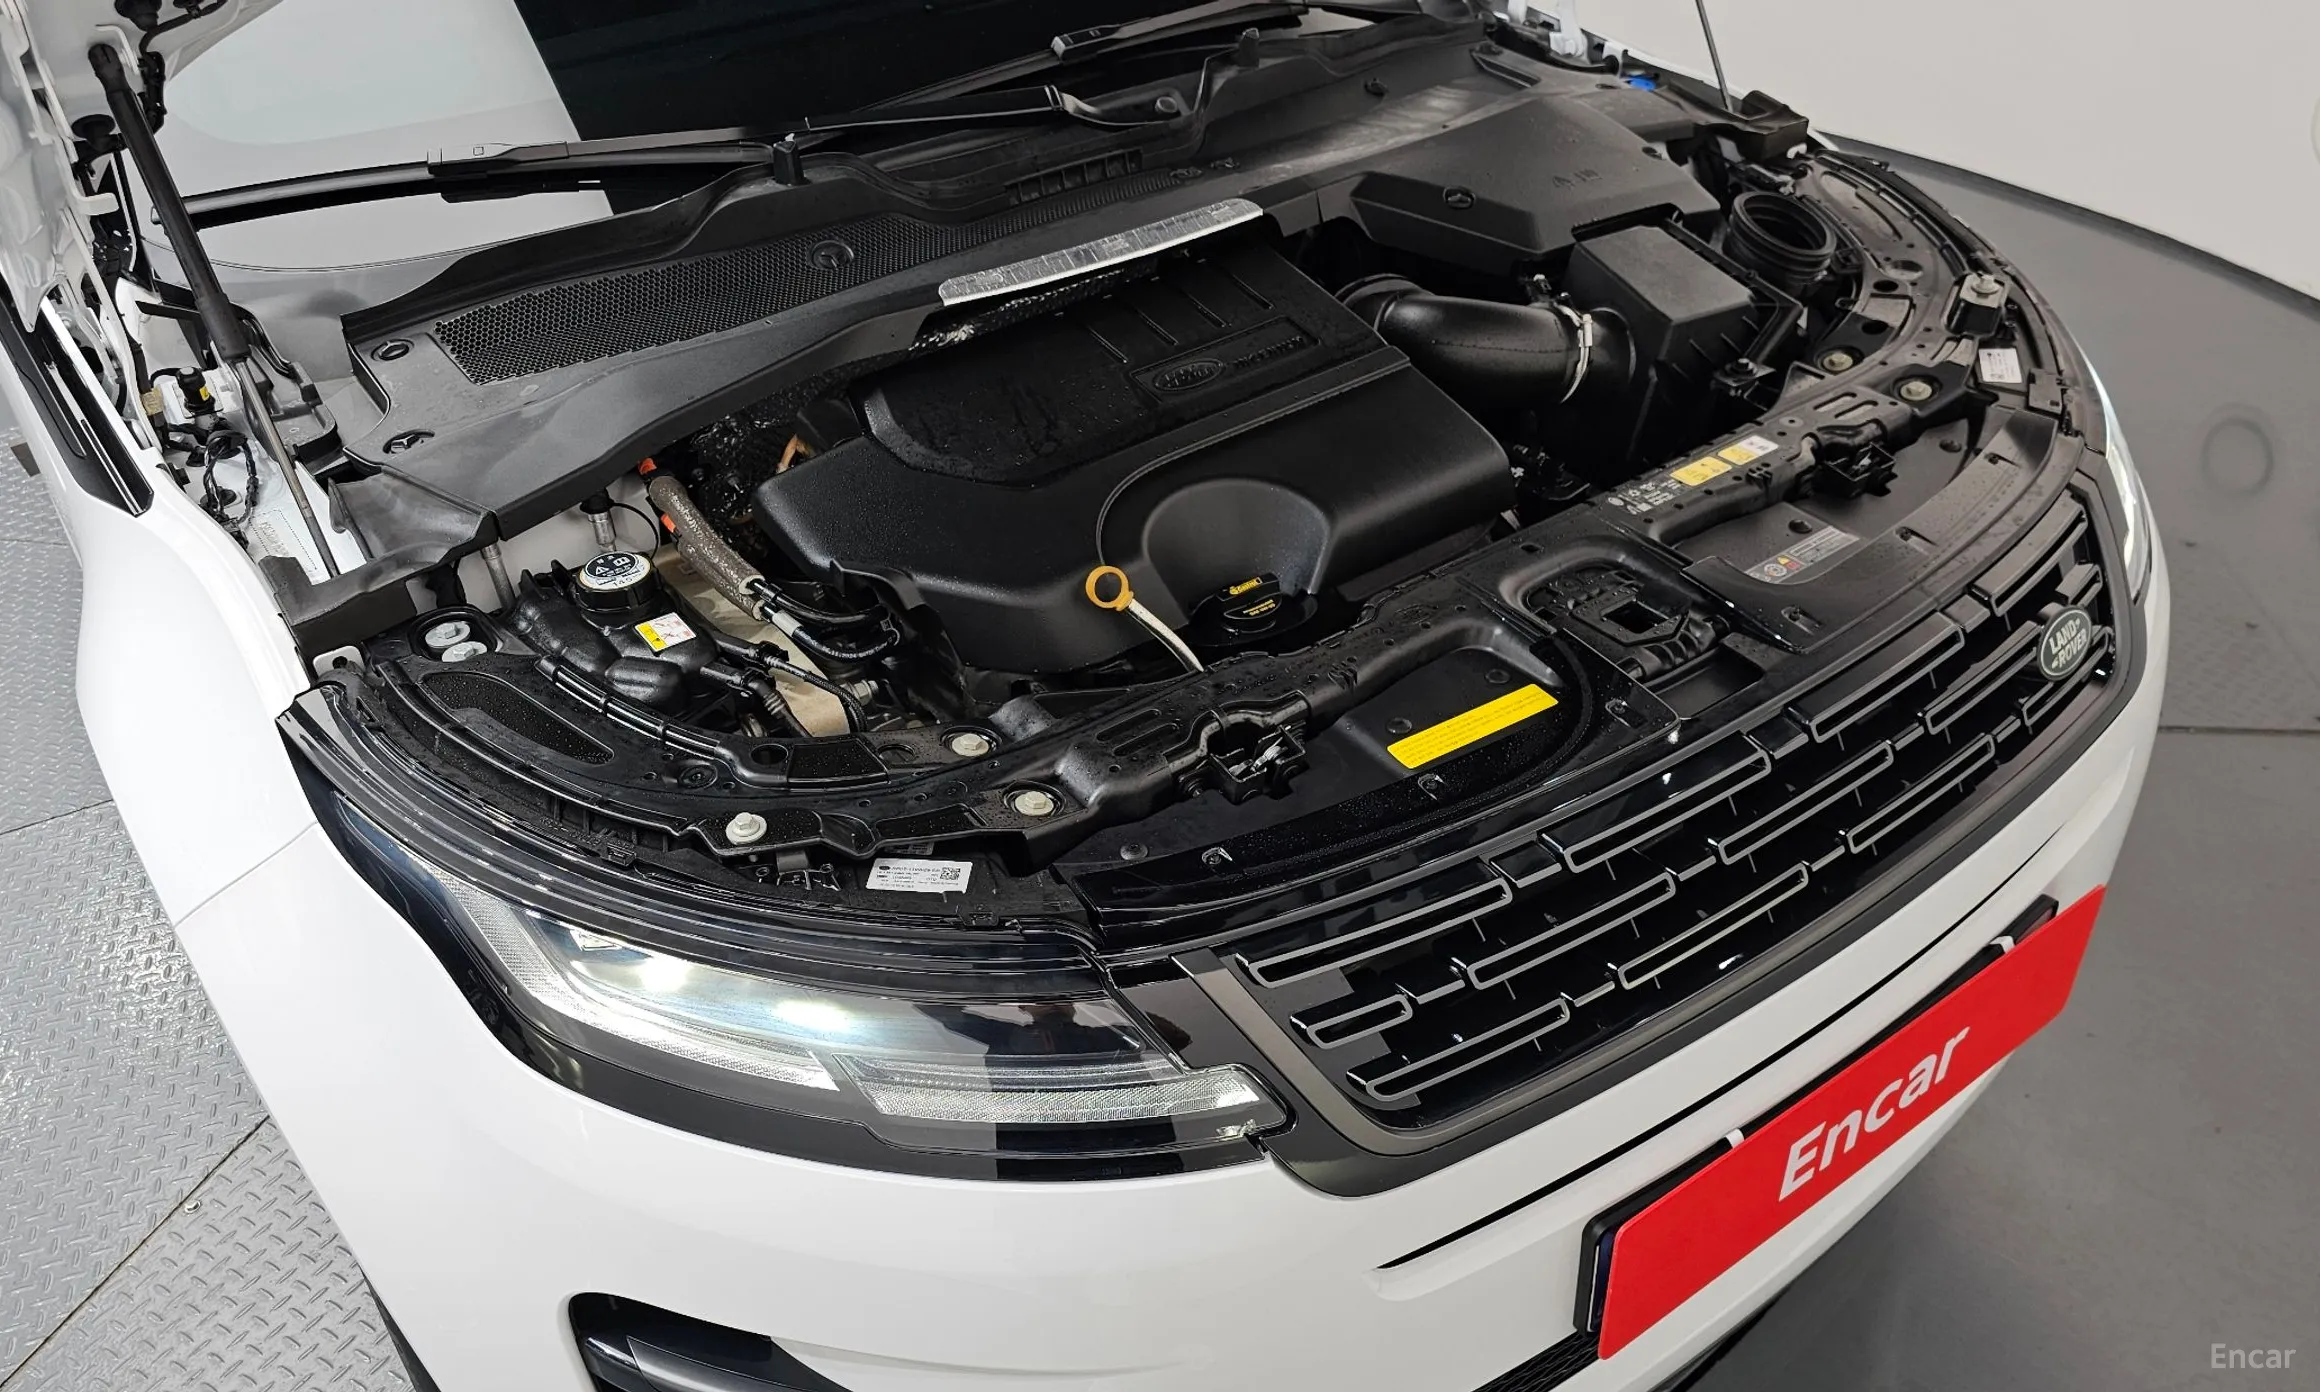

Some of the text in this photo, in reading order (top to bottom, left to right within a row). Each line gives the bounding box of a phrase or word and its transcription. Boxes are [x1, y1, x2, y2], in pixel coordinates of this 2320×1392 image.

[2049, 619, 2077, 655] LAND
[2058, 628, 2087, 668] ROVER
[1778, 1026, 1971, 1202] Encar
